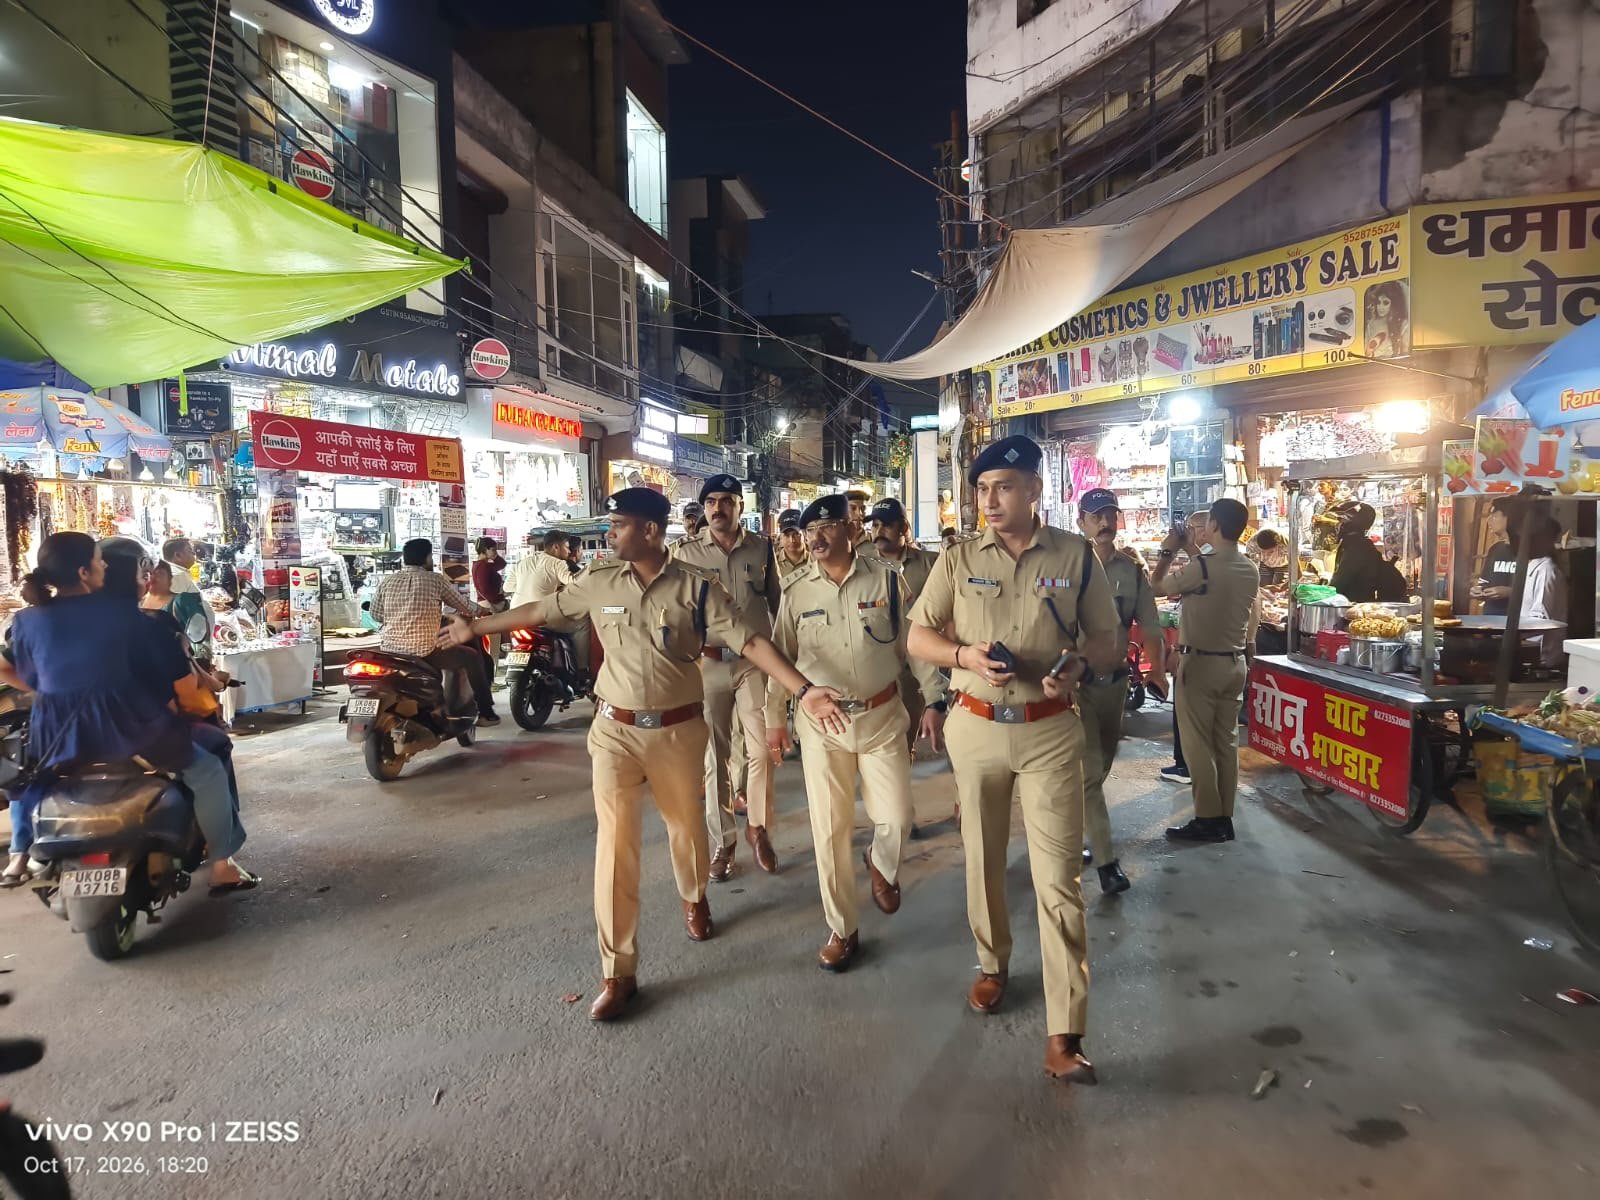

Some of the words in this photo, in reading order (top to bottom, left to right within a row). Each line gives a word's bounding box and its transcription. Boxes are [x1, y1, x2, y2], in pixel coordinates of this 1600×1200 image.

[291, 162, 335, 185] Hawkins
[1343, 221, 1401, 243] 9528755224
[1048, 297, 1149, 349] COSMETICS
[1154, 293, 1172, 323] &
[1177, 255, 1312, 318] JWELLERY
[1319, 232, 1400, 287] SALE
[472, 351, 509, 367] Hawkins
[349, 348, 460, 397] Metals
[997, 406, 1011, 416] Sale
[261, 435, 300, 450] Hawkins
[315, 430, 353, 449] आपकी
[356, 433, 382, 453] रसोई
[384, 436, 394, 452] के
[396, 437, 416, 456] लिए
[315, 448, 338, 468] यहाँ
[340, 451, 359, 470] पाएँ
[362, 455, 387, 471] सबसे
[390, 459, 417, 473] अच्छा
[1251, 673, 1310, 760] सोनू
[1324, 692, 1370, 738] चाट
[1312, 731, 1383, 790] भण्डार
[73, 881, 119, 896] A3716
